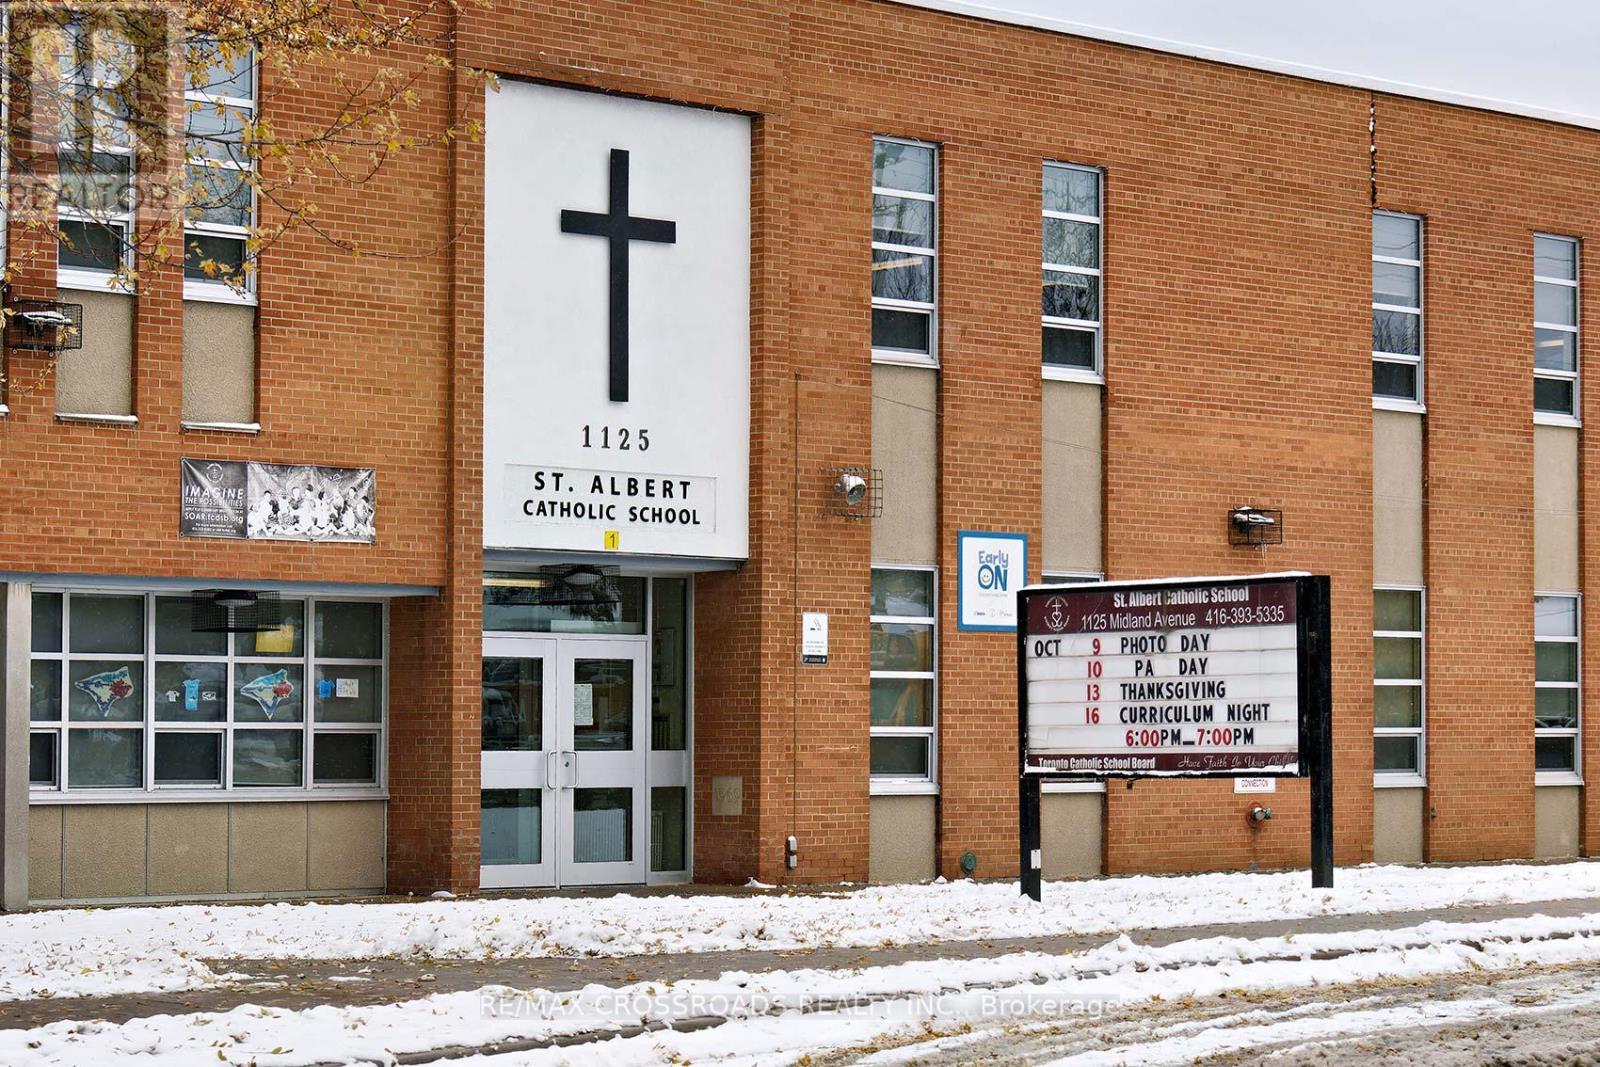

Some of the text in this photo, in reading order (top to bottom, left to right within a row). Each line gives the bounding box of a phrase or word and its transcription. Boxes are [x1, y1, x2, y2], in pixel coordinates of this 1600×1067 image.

[582, 425, 649, 451] 1125
[185, 486, 244, 499] IMAGINE
[534, 471, 690, 499] ST. ALBERT
[523, 499, 700, 525] CATHOLIC SCHOOL
[610, 533, 615, 548] 1
[978, 550, 1008, 568] Early
[978, 564, 1008, 591] ON
[1114, 592, 1127, 608] St.
[1129, 591, 1162, 607] Albert
[1211, 586, 1249, 602] School
[1081, 613, 1107, 630] 1125
[1109, 611, 1151, 629] Midland
[1154, 610, 1196, 627] Avenue
[1205, 604, 1285, 624] 416-393-5335
[1034, 633, 1210, 657] OCT 9 PHOTO DAY
[1087, 658, 1208, 678] 10 PA DAY
[1086, 681, 1226, 701] 13 THANKSGIVING
[1085, 703, 1270, 724] 16 CURRICULUM NIGHT
[1039, 757, 1156, 769] Toronto Catholic School Board
